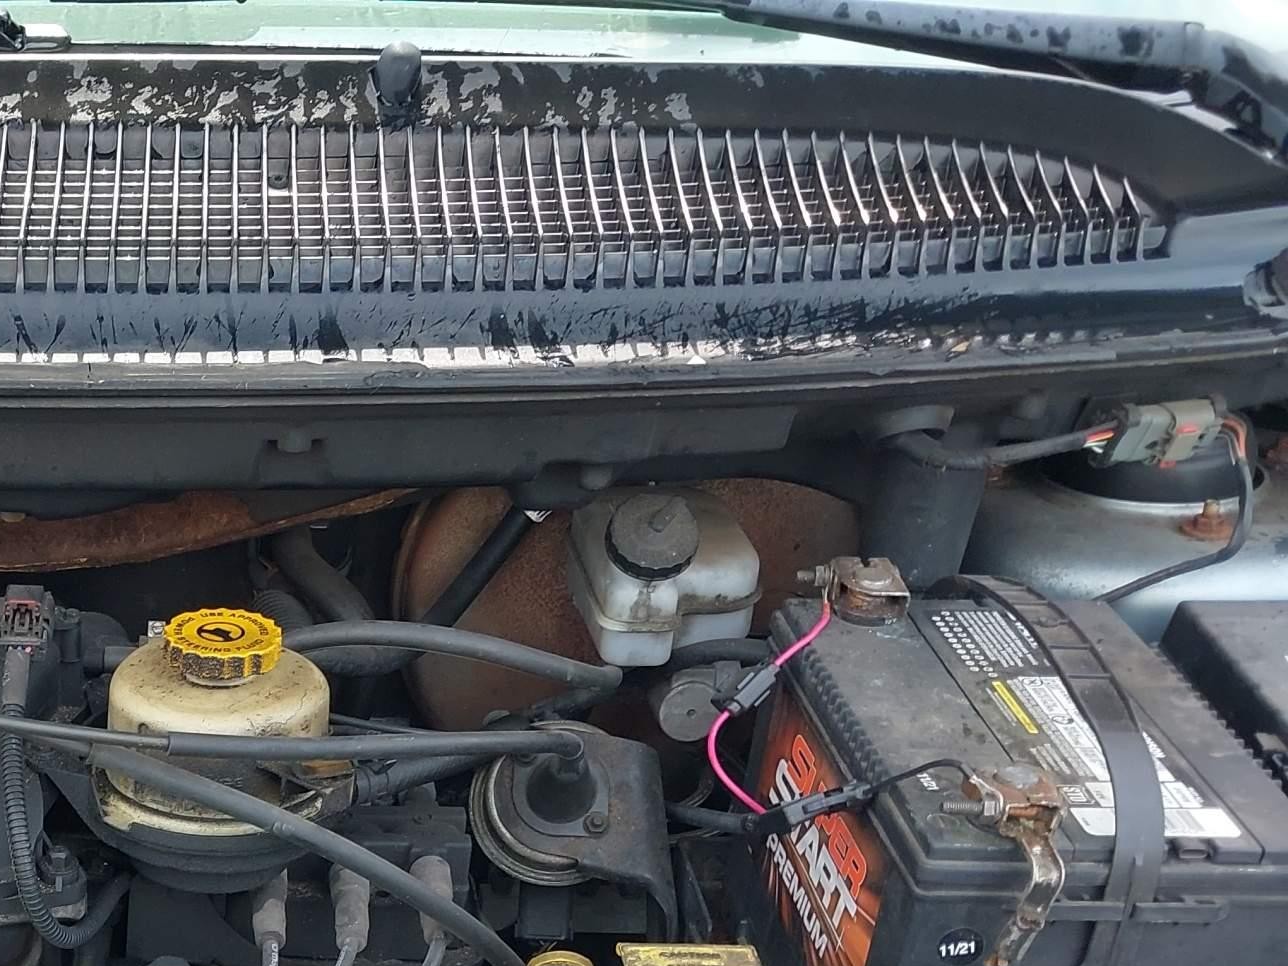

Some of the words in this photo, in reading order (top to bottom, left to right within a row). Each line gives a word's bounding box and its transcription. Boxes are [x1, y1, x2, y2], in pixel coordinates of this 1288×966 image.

[173, 616, 195, 636] POWER
[230, 613, 270, 636] APPROVED
[178, 637, 232, 653] STEERING
[916, 773, 940, 791] 11/21
[766, 833, 829, 959] PREMIUM
[939, 940, 976, 959] 11/21
